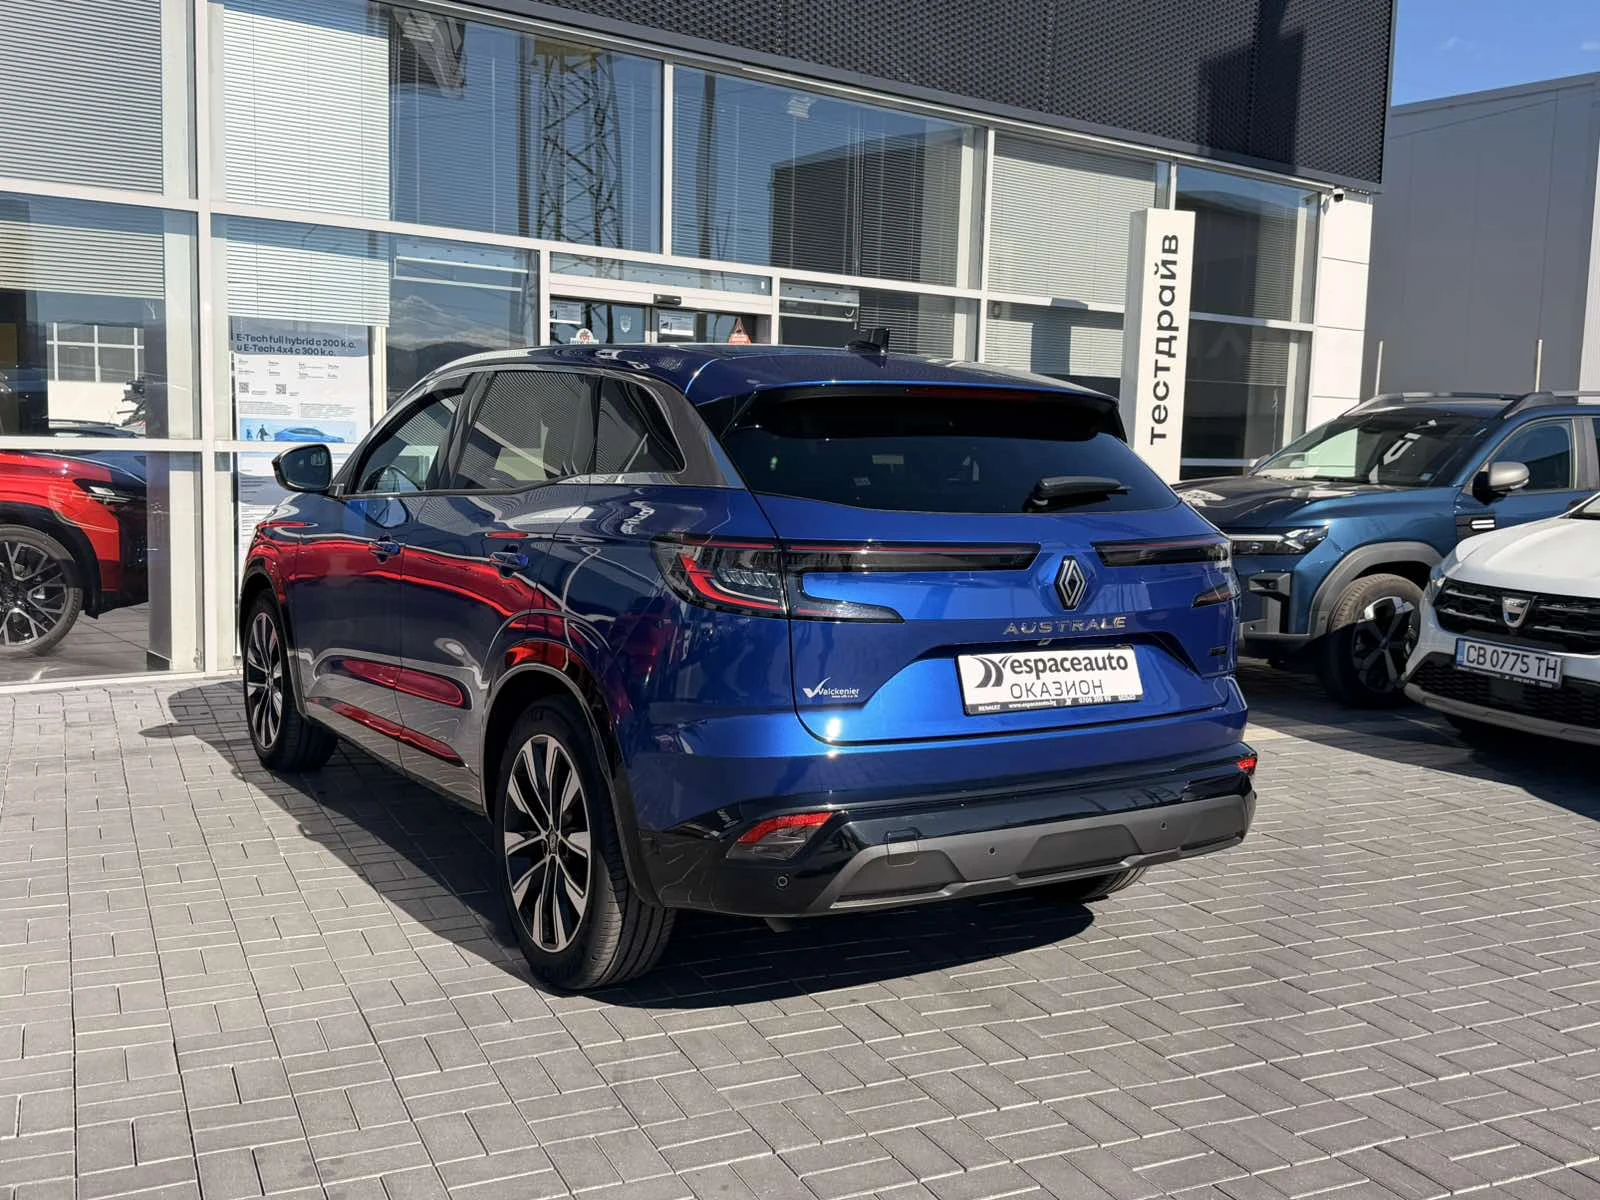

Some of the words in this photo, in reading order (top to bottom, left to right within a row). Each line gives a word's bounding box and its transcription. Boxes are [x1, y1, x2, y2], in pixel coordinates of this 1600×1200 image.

[236, 333, 268, 343] E-Tech
[269, 335, 284, 344] full
[285, 336, 315, 347] hybrid
[322, 339, 340, 347] 200
[243, 344, 275, 353] E-Tech
[277, 345, 294, 354] 4x4
[302, 347, 319, 355] 300
[1150, 234, 1179, 445] тестдрайв
[1009, 652, 1129, 680] espaceauto
[1465, 645, 1487, 666] CB
[1490, 650, 1530, 674] 0775
[1534, 656, 1558, 680] TH
[1010, 679, 1104, 699] ОКАЗИОН
